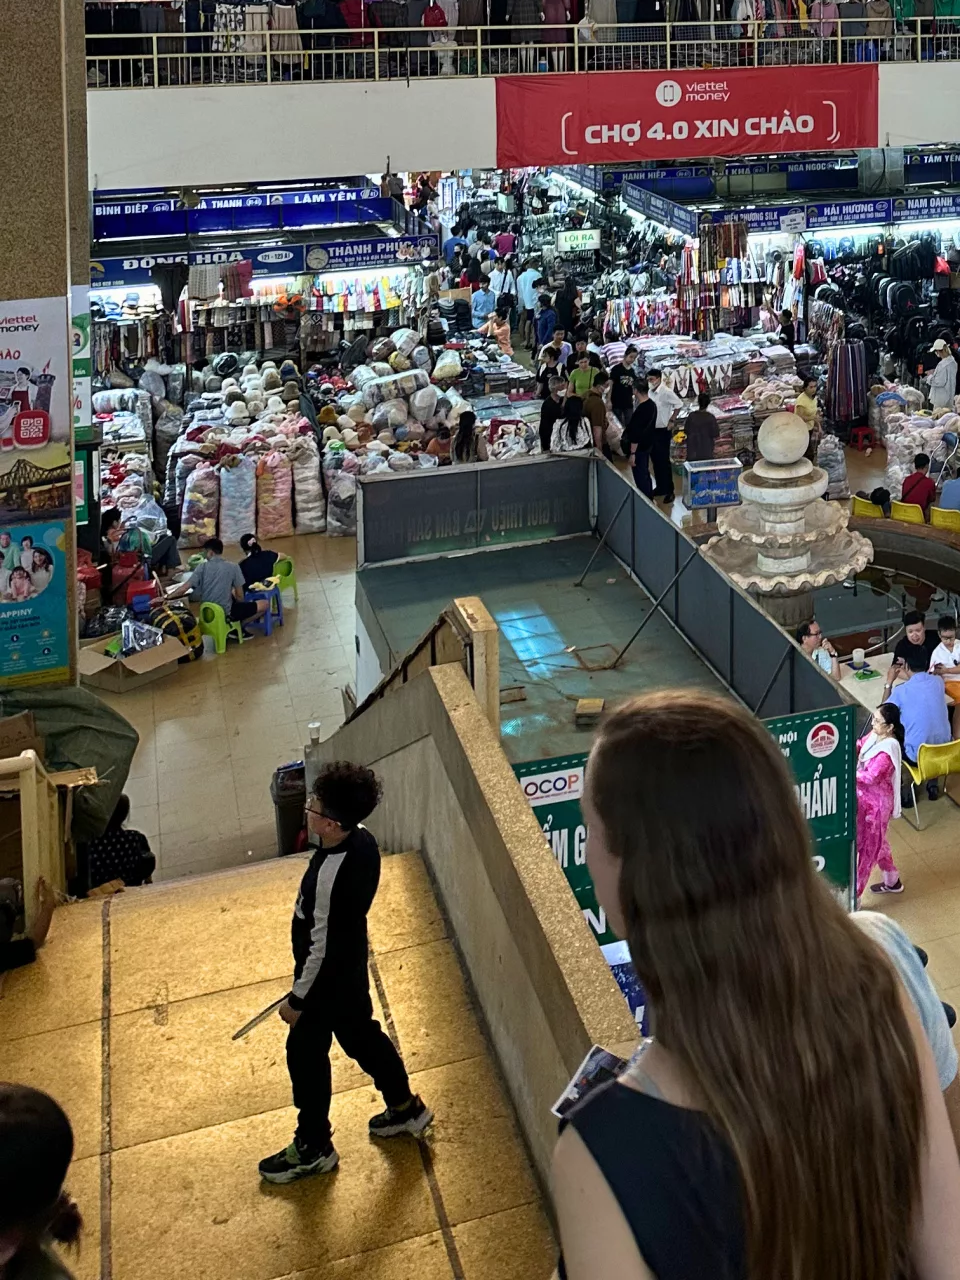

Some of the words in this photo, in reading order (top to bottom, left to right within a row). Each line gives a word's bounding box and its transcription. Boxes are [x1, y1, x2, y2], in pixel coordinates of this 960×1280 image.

[686, 81, 728, 92] viettel
[685, 91, 731, 102] money
[585, 120, 641, 146] CHỢ
[647, 121, 688, 140] 4.0
[693, 119, 739, 139] XIN
[745, 109, 815, 135] CHÀO
[945, 154, 960, 162] YÊN
[788, 164, 804, 172] NGA
[212, 198, 242, 208] THANH
[295, 192, 325, 204] LÂM
[329, 190, 357, 202] YÊN
[908, 199, 928, 209] NAM
[930, 197, 953, 207] OANH
[95, 203, 121, 217] BÌNH
[824, 204, 839, 215] HẢI
[842, 203, 874, 214] HƯƠNG
[765, 211, 778, 220] SILK
[582, 233, 594, 241] RA
[328, 243, 371, 257] THÀNH
[195, 252, 244, 265] HOA
[1, 608, 33, 618] APPINY
[779, 730, 798, 744] NỘI
[524, 774, 579, 797] OCOP
